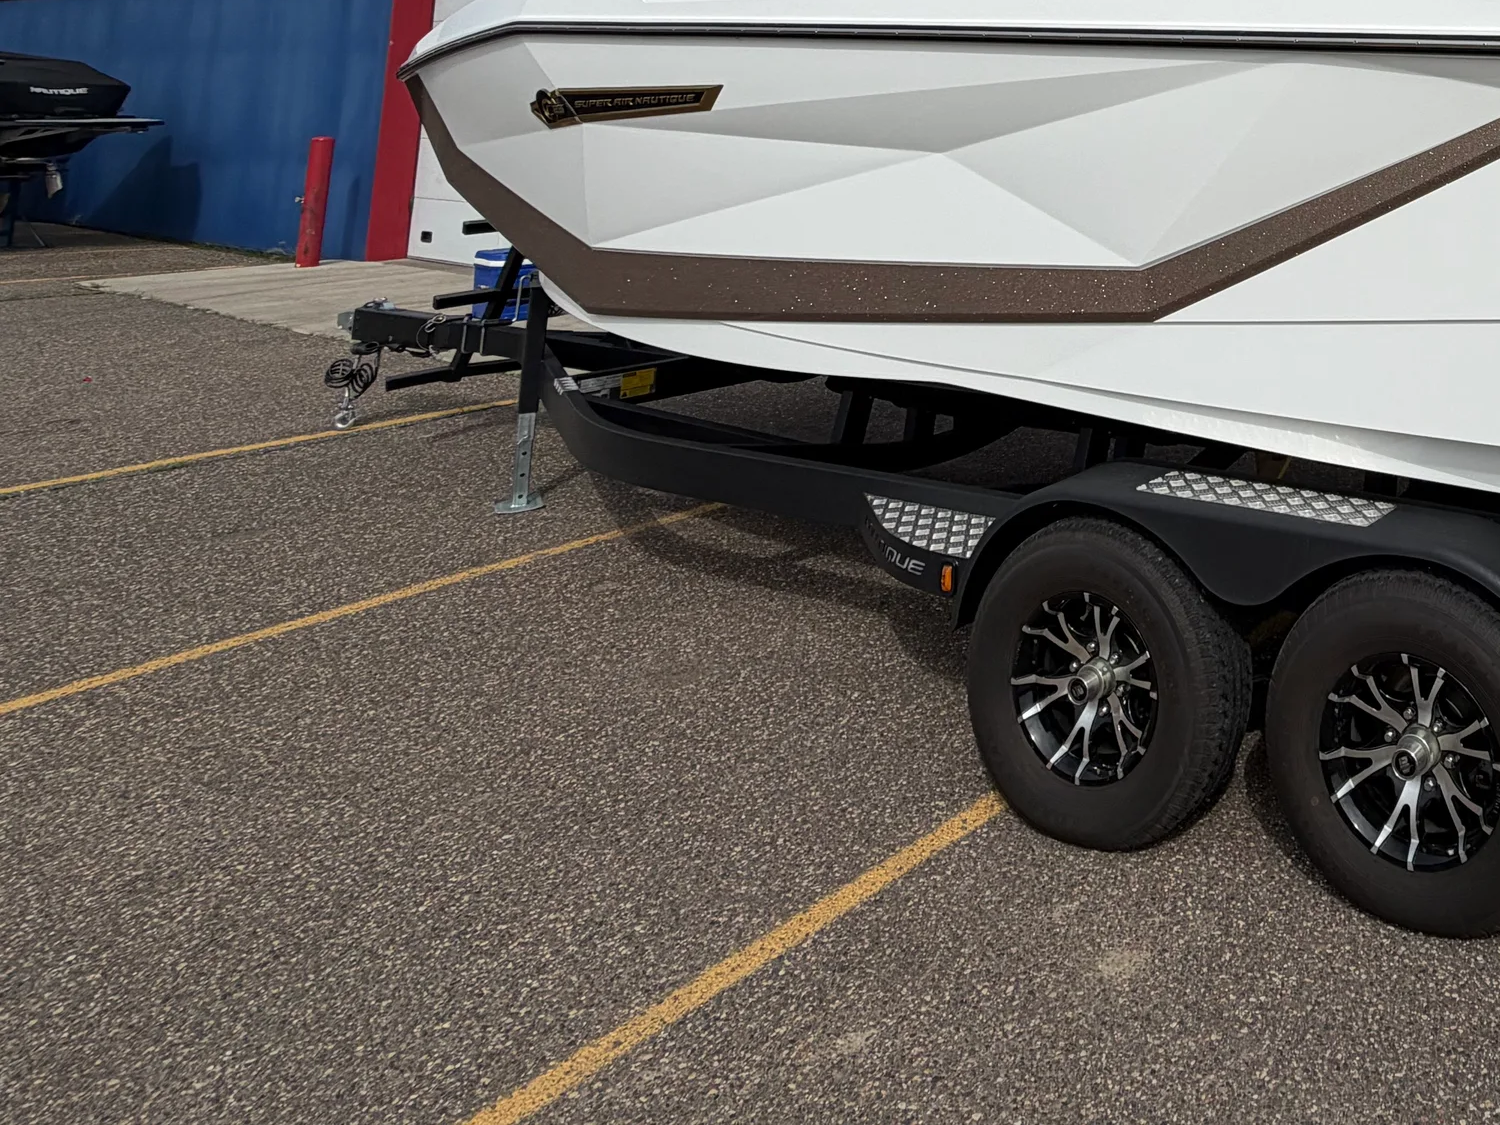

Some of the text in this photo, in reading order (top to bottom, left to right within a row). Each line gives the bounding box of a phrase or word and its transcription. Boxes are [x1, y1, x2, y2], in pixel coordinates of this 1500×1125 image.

[574, 93, 696, 108] SUPER AIR NAUTIQUE
